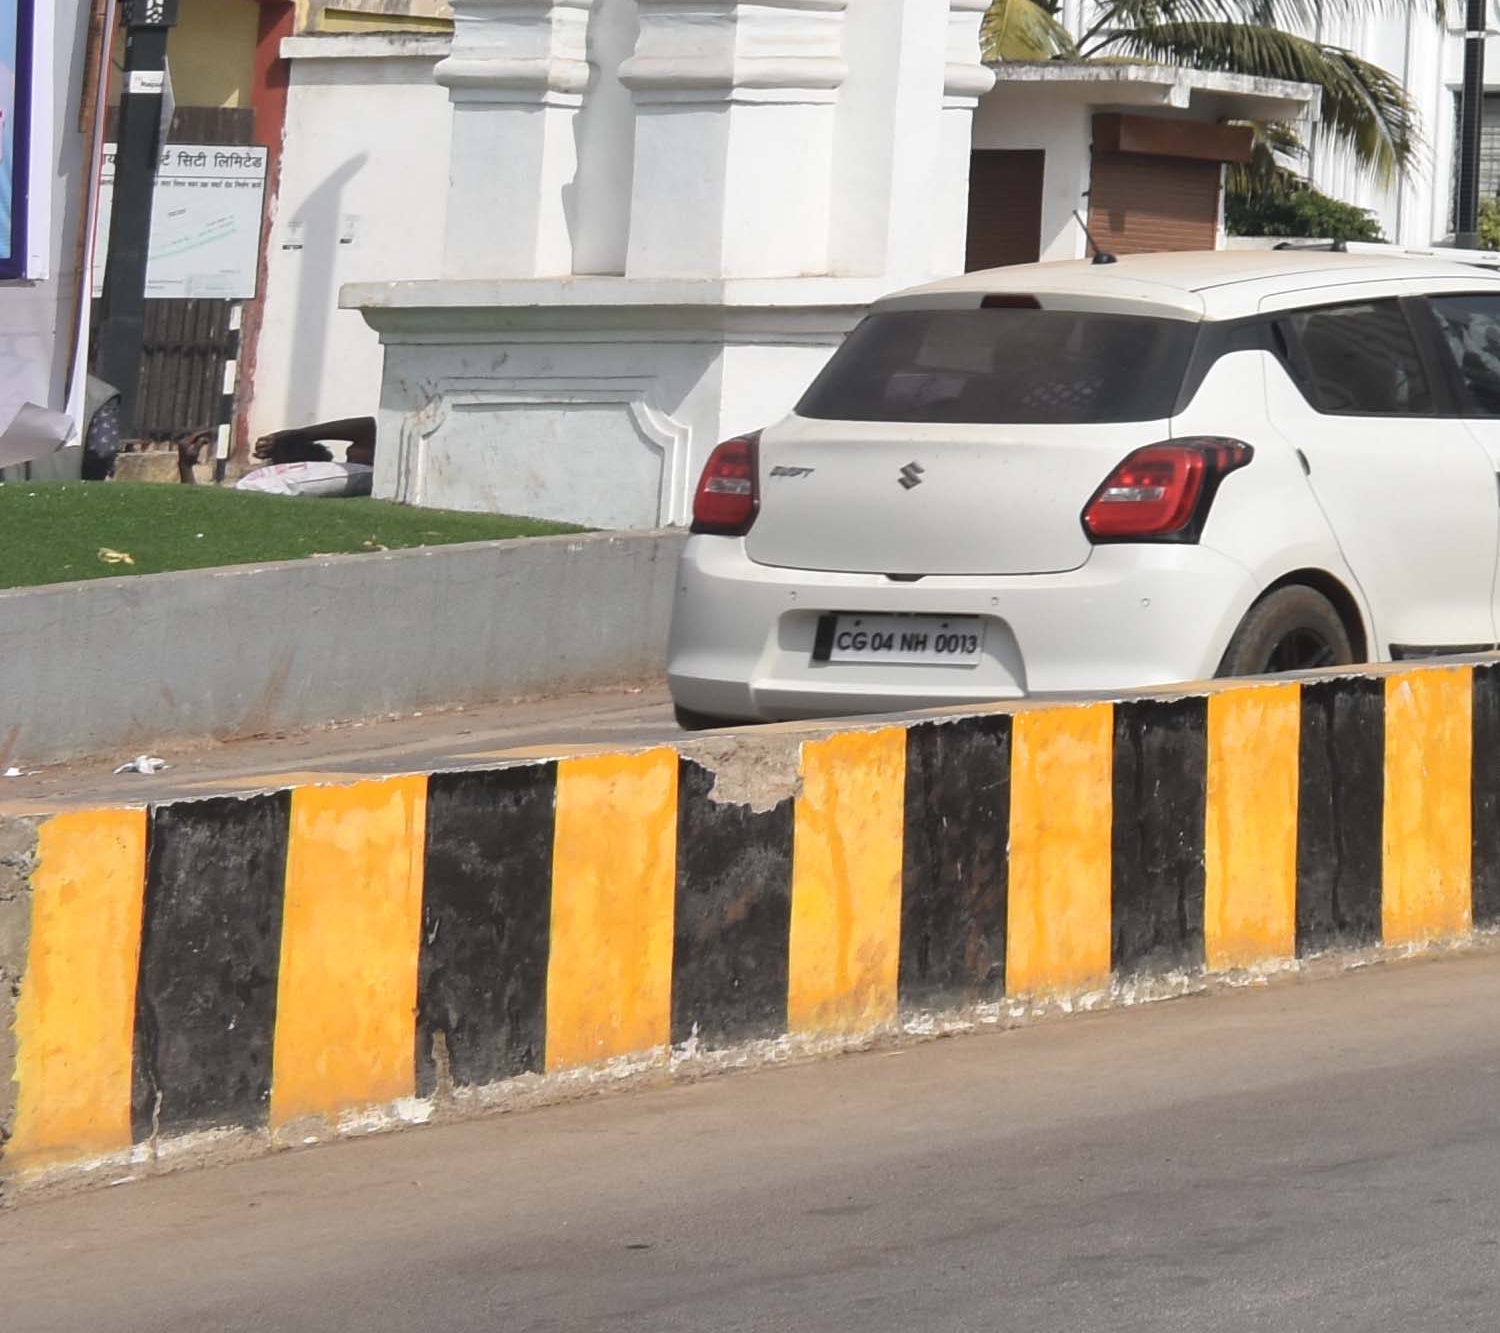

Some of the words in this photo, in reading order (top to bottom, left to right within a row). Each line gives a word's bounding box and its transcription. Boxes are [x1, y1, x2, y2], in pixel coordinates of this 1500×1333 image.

[177, 150, 207, 168] सिटी
[214, 151, 262, 169] लिमिटेड
[837, 631, 868, 652] CG
[871, 632, 893, 652] 04
[900, 633, 927, 652] NH
[934, 634, 978, 654] 0013
